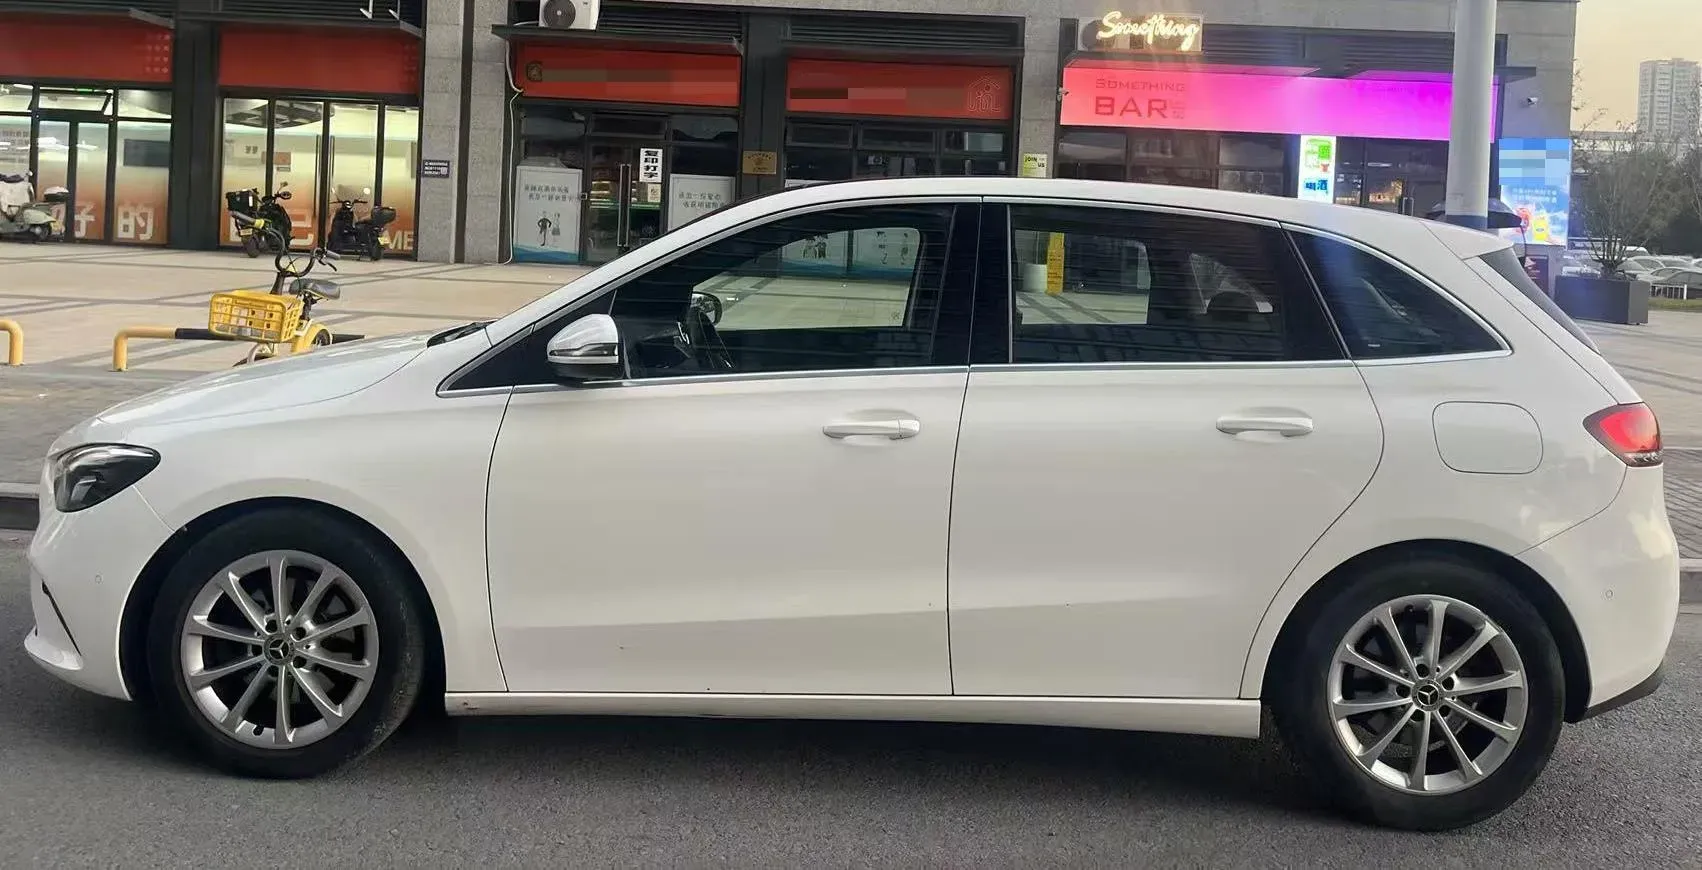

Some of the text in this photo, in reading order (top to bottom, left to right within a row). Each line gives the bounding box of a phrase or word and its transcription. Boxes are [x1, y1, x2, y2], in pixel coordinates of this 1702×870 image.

[1096, 11, 1200, 51] Something
[1095, 78, 1186, 92] SOMETHING
[1095, 96, 1168, 119] BAR
[643, 150, 660, 178] 复印打字
